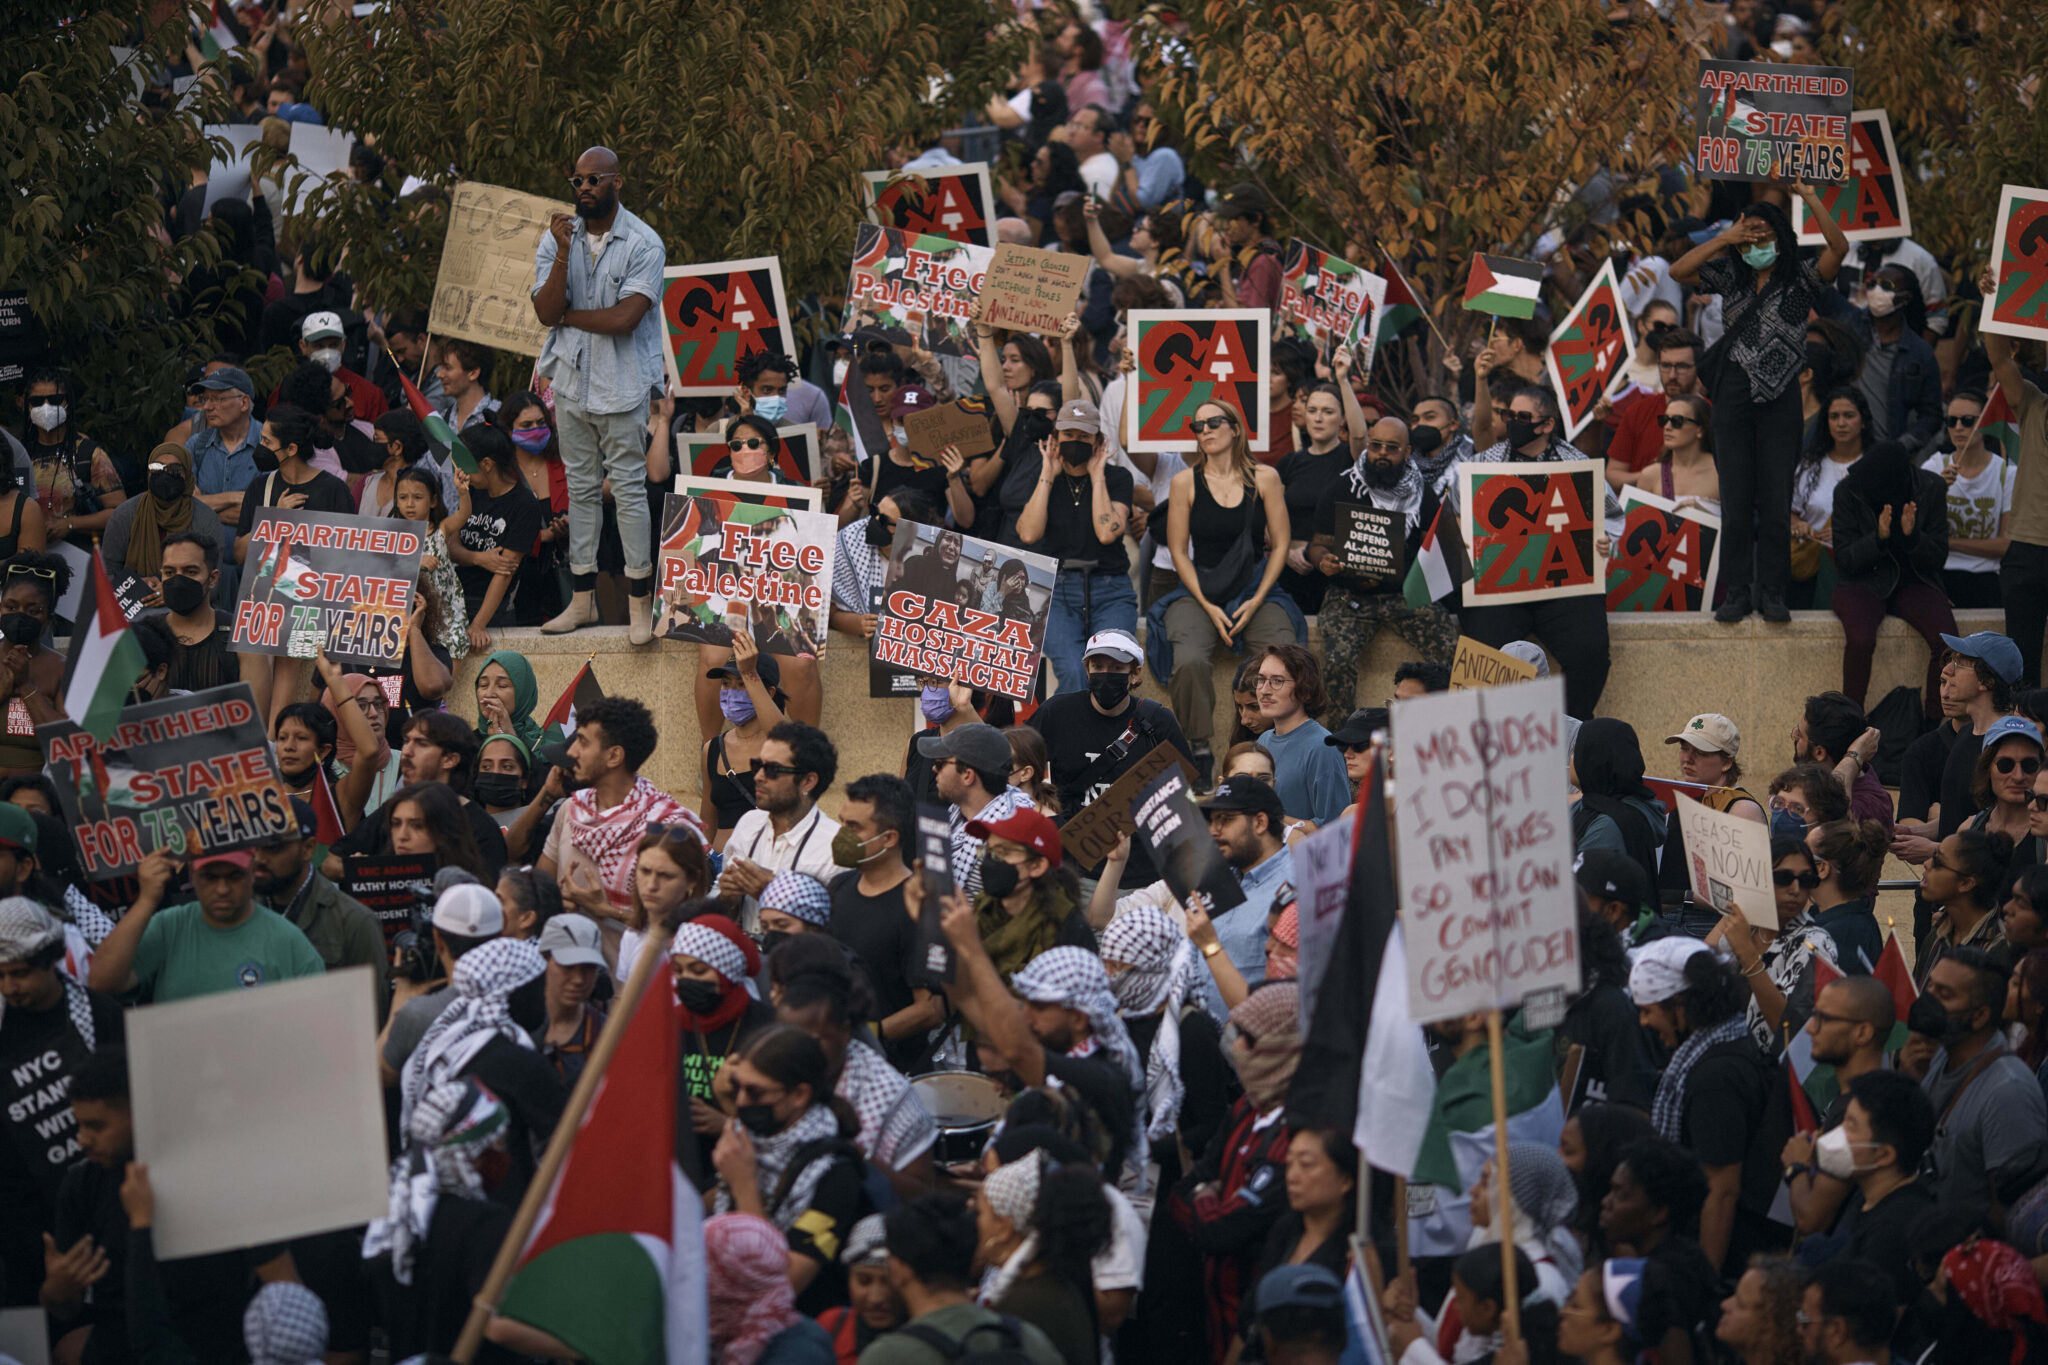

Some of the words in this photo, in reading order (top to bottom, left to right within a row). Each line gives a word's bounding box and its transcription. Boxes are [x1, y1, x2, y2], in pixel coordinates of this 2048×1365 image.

[1701, 70, 1848, 96] APARTHEID
[1745, 111, 1847, 139] STATE
[1697, 136, 1740, 174] FOR
[1746, 139, 1771, 176] 75
[1776, 140, 1845, 181] YEARS
[443, 238, 537, 298] WATE
[852, 272, 970, 319] Palestin
[903, 391, 919, 404] H
[252, 519, 420, 556] APARTHEID
[1350, 510, 1392, 525] DEFEND
[1354, 521, 1387, 536] GAZA
[719, 521, 825, 574] Free
[1343, 541, 1394, 559] AL-AQSA
[1349, 530, 1390, 547] DEFEND
[1347, 552, 1389, 567] DEFEND
[294, 571, 412, 609] STATE
[662, 556, 823, 611] Palestine
[232, 599, 285, 647] FOR
[290, 604, 321, 631] 75
[325, 607, 402, 659] YEARS
[888, 590, 1034, 652] GAZA
[882, 616, 1034, 676] HOSPITAL
[876, 638, 1031, 700] MASSACRE
[7, 725, 35, 735] STATE
[8, 711, 31, 721] ABOLIS
[1412, 724, 1472, 777] MR
[1470, 710, 1560, 770] BIDEN
[128, 747, 272, 804] STATE
[76, 816, 144, 872] FOR
[140, 806, 187, 856] 75
[181, 787, 288, 849] YEARS
[1066, 794, 1112, 838] NOT
[1407, 786, 1435, 838] I
[1692, 812, 1744, 850] CEASE
[1079, 810, 1128, 861] OUR
[1428, 832, 1474, 873] PAY
[1490, 811, 1556, 860] TAXES
[352, 881, 387, 892] KATHY
[388, 877, 434, 890] HOCHUL
[1712, 846, 1768, 889] NOW!
[1411, 880, 1451, 921] SO
[11, 1050, 62, 1088] NYC
[34, 1106, 78, 1139] WIT
[47, 1138, 83, 1164] GA
